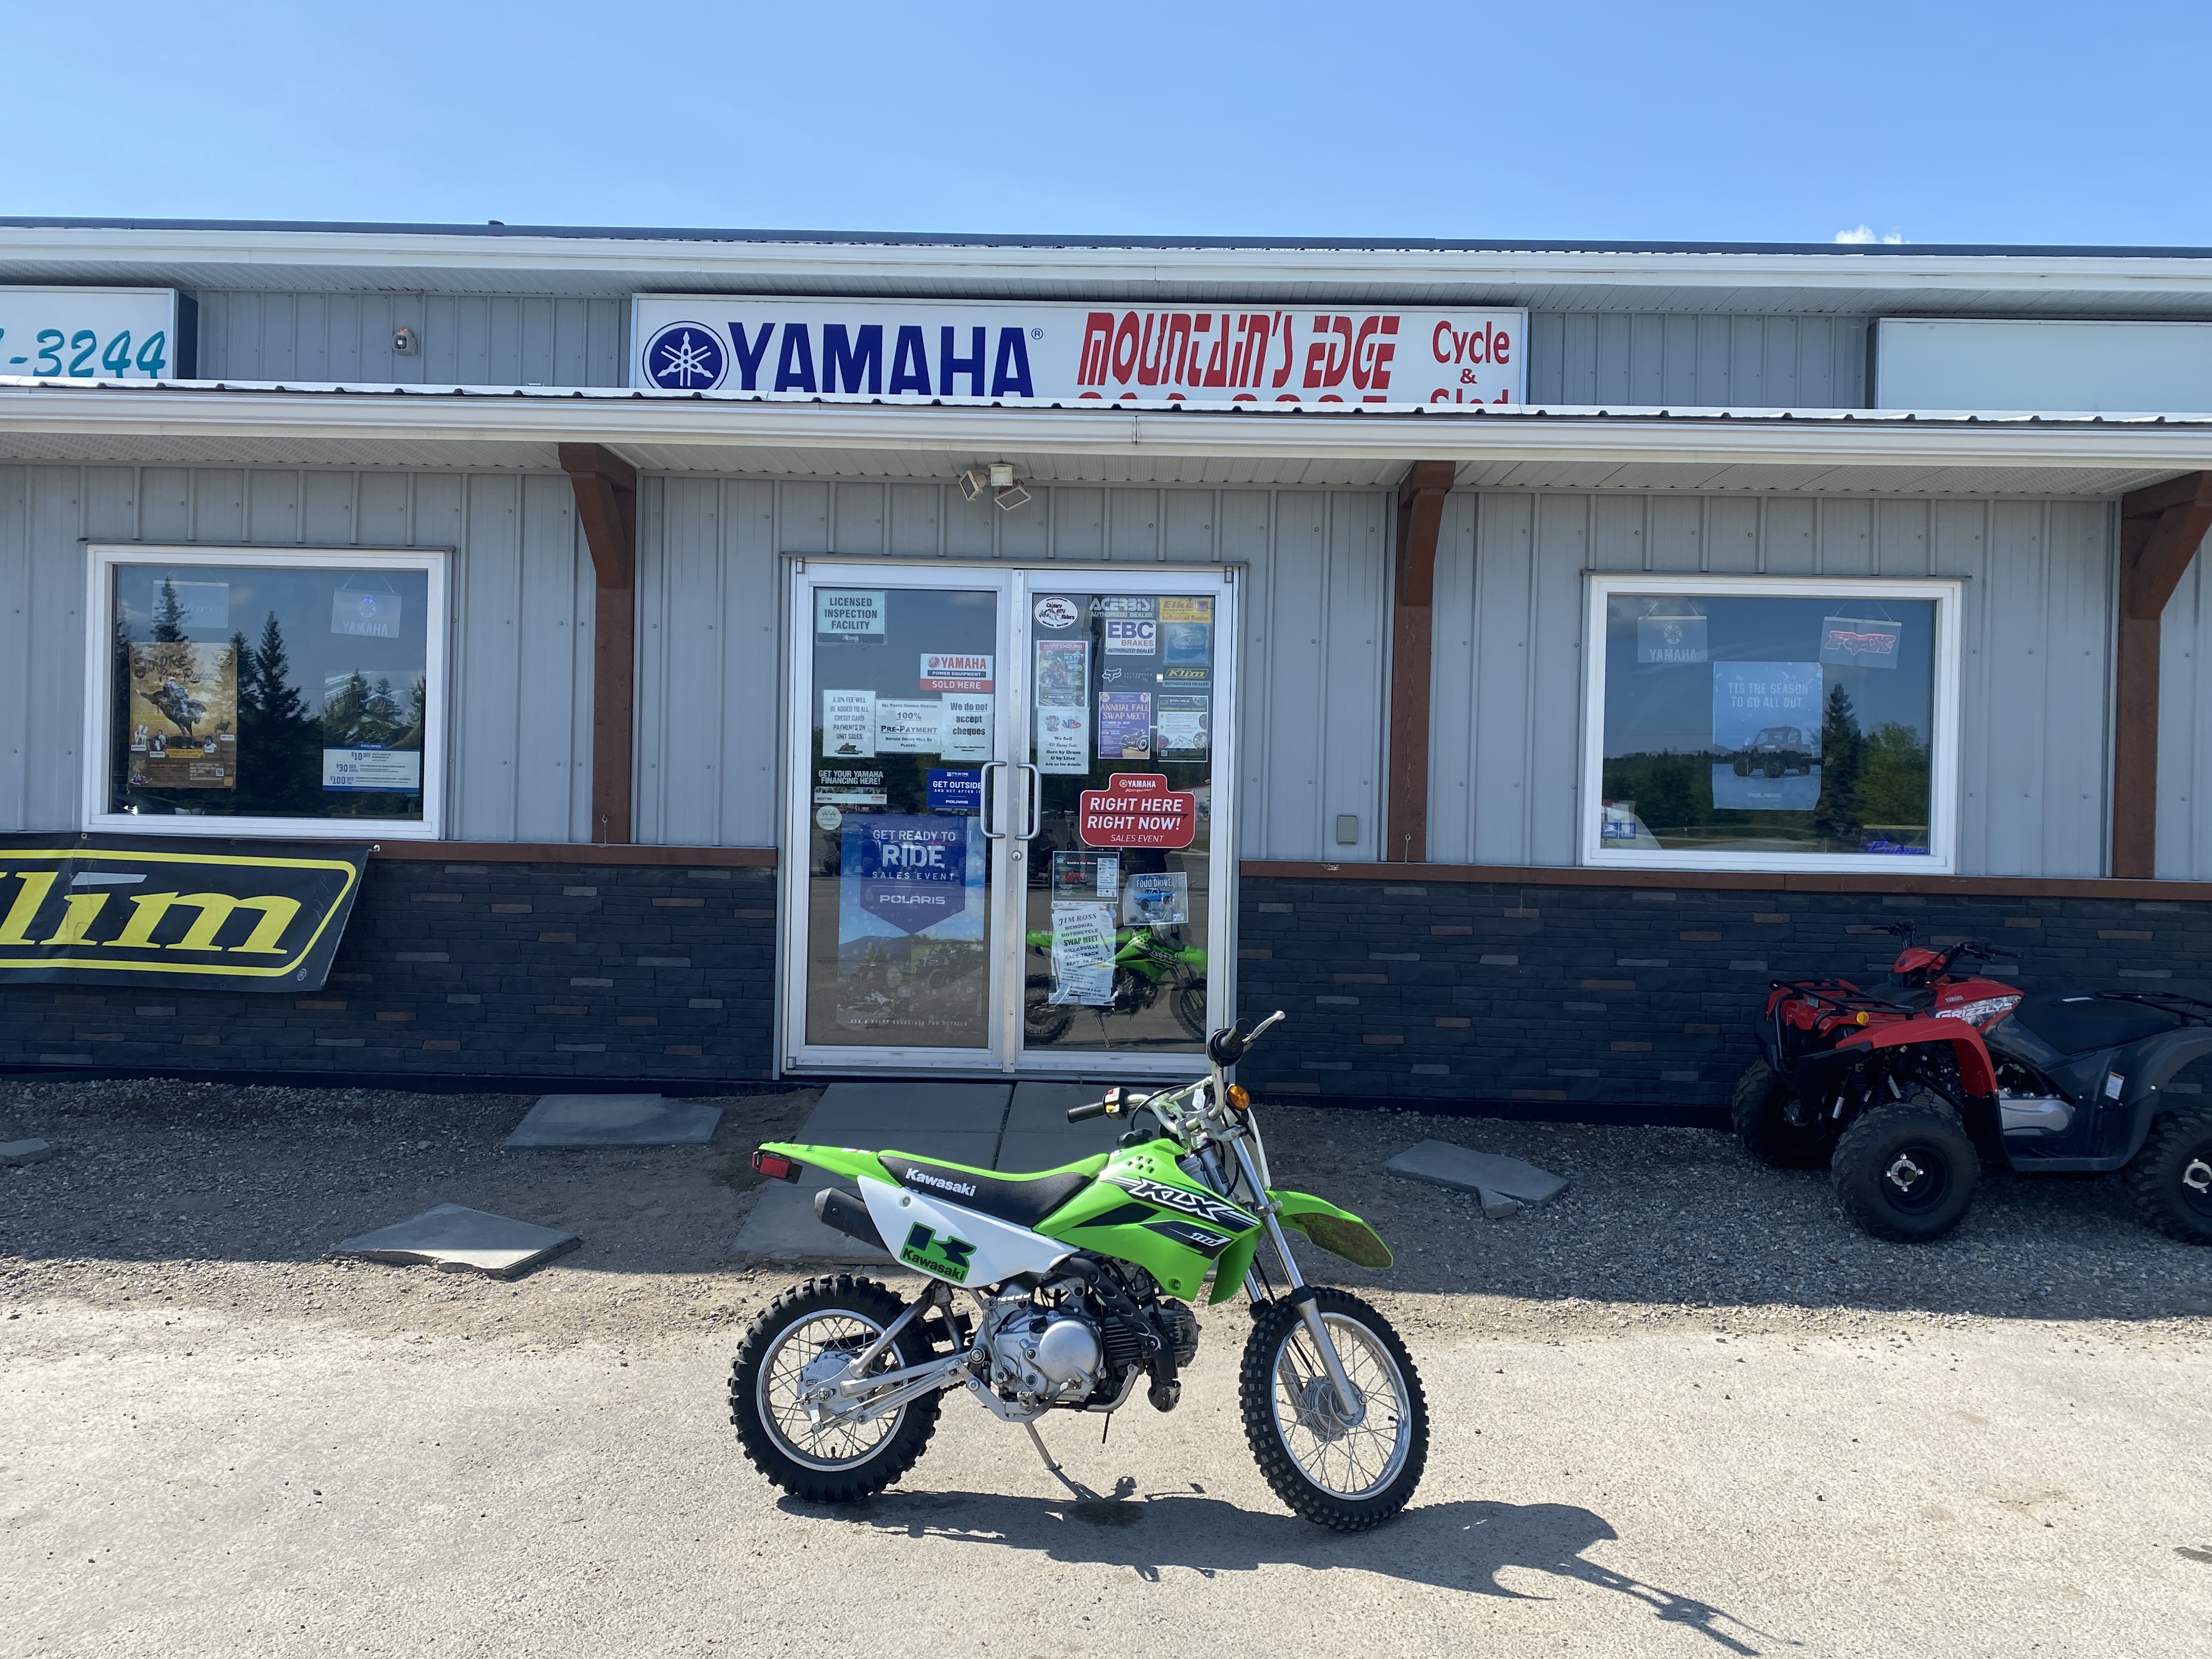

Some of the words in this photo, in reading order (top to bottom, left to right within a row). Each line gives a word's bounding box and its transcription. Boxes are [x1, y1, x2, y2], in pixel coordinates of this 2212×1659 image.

[1432, 320, 1510, 365] Cycle
[0, 328, 166, 379] -3244
[1077, 311, 1293, 388] MOUNTAIN'S
[1303, 315, 1400, 390] EDGE
[727, 321, 1034, 398] YAMAHA
[1460, 368, 1477, 384] &
[830, 597, 872, 607] LICENSED
[1089, 597, 1150, 612] ACERBIS
[825, 608, 877, 618] INSPECTION
[343, 620, 388, 636] YAMAHA
[831, 620, 870, 630] FACILITY
[1108, 621, 1154, 639] EBC
[1649, 648, 1697, 661] YAMAHA
[941, 657, 986, 669] YAMAHA
[183, 668, 217, 684] Rodeo
[1167, 669, 1205, 678] Klim
[932, 680, 955, 689] SOLD
[1728, 682, 1745, 694] TIS
[1748, 683, 1767, 694] THE
[1770, 684, 1809, 695] SEASON
[950, 702, 962, 710] We
[964, 702, 974, 710] do
[975, 703, 988, 711] not
[1731, 696, 1743, 707] TO
[1747, 696, 1760, 707] GO
[1763, 697, 1780, 708] ALL
[1784, 697, 1804, 708] OUT.
[956, 715, 983, 724] accept
[952, 727, 985, 736] cheques
[351, 752, 363, 761] $10
[336, 763, 348, 772] $30
[330, 775, 346, 785] $100
[1090, 798, 1138, 811] RIGHT
[1141, 798, 1183, 812] HERE
[1087, 816, 1135, 829] RIGHT
[1138, 817, 1181, 830] NOW!
[873, 830, 896, 840] GET
[899, 830, 938, 840] READY
[941, 831, 956, 842] TO
[1110, 834, 1136, 842] SALES
[1138, 834, 1164, 843] EVENT
[882, 844, 945, 868] RIDE
[872, 871, 910, 879] SALES
[917, 872, 955, 881] EVENT
[1154, 878, 1172, 887] DRIVE
[880, 895, 945, 905] POLARIS
[0, 871, 301, 954] lim
[1058, 916, 1074, 926] JIM
[1076, 913, 1097, 922] ROSS
[1061, 928, 1098, 938] MOTORCYCLE
[1063, 938, 1082, 946] SWAP
[1083, 935, 1098, 943] MEET
[1064, 944, 1099, 953] MILLARVILLE
[1936, 1003, 2003, 1018] GRIZZLY
[906, 1168, 977, 1197] Kawasaki
[1128, 1178, 1235, 1222] KLX
[902, 1248, 966, 1281] Kawasaki
